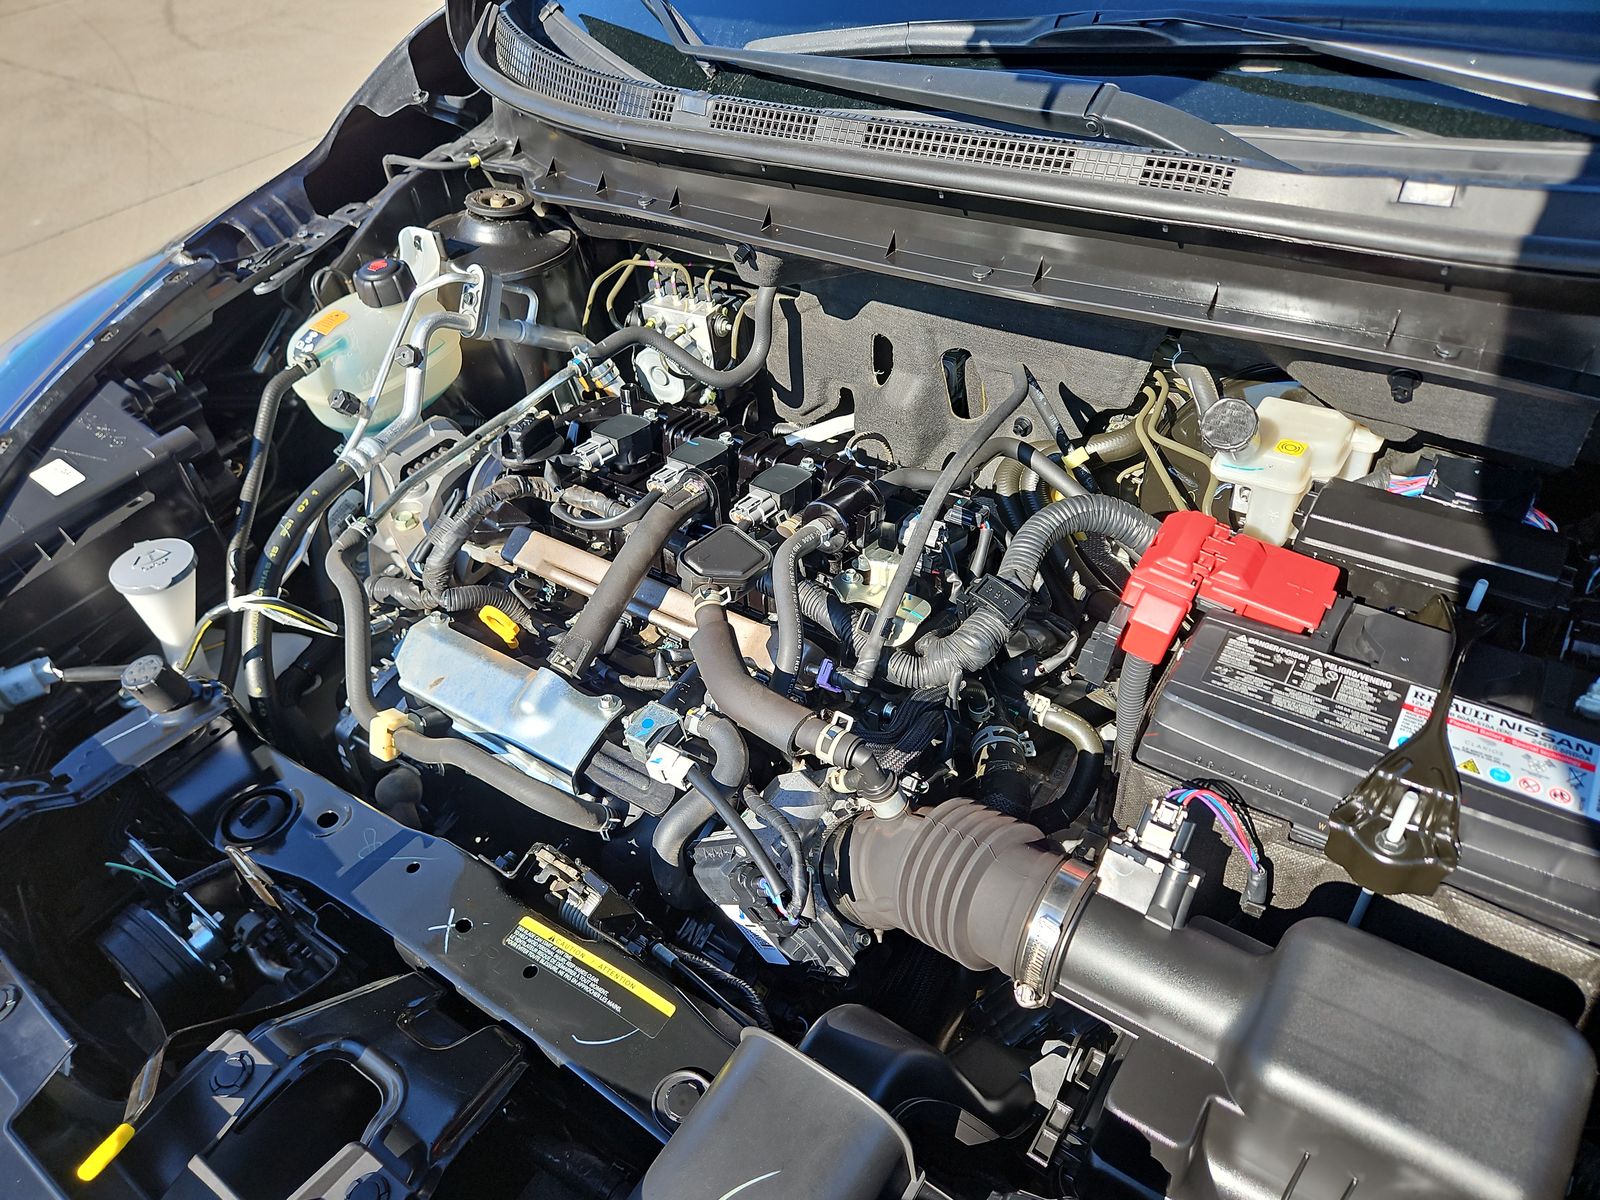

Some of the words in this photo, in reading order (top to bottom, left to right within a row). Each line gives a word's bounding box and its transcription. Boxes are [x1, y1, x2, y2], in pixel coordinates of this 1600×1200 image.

[1248, 637, 1310, 662] DANGER/POISON
[1324, 661, 1392, 689] PELIGRO/VENENO
[1414, 691, 1494, 722] REAULT
[1499, 719, 1593, 756] NISSAN
[1449, 720, 1478, 733] Flooded
[1479, 728, 1506, 742] Battery
[1512, 740, 1538, 753] Special
[1539, 750, 1582, 767] technology
[505, 937, 517, 947] POUR
[527, 951, 540, 962] TOUTE
[563, 972, 572, 981] PAS
[575, 980, 601, 999] APPROCHER
[599, 994, 608, 1003] LES
[606, 999, 622, 1012] MAINS.
[513, 936, 538, 953] VENTILATEUR
[578, 975, 591, 985] TOUT
[518, 932, 527, 940] HELP
[565, 960, 576, 969] KEEP
[574, 965, 588, 976] HANDS
[586, 972, 600, 984] CLEAR.
[554, 938, 586, 959] CAUTION
[598, 963, 637, 990] ATTENTION
